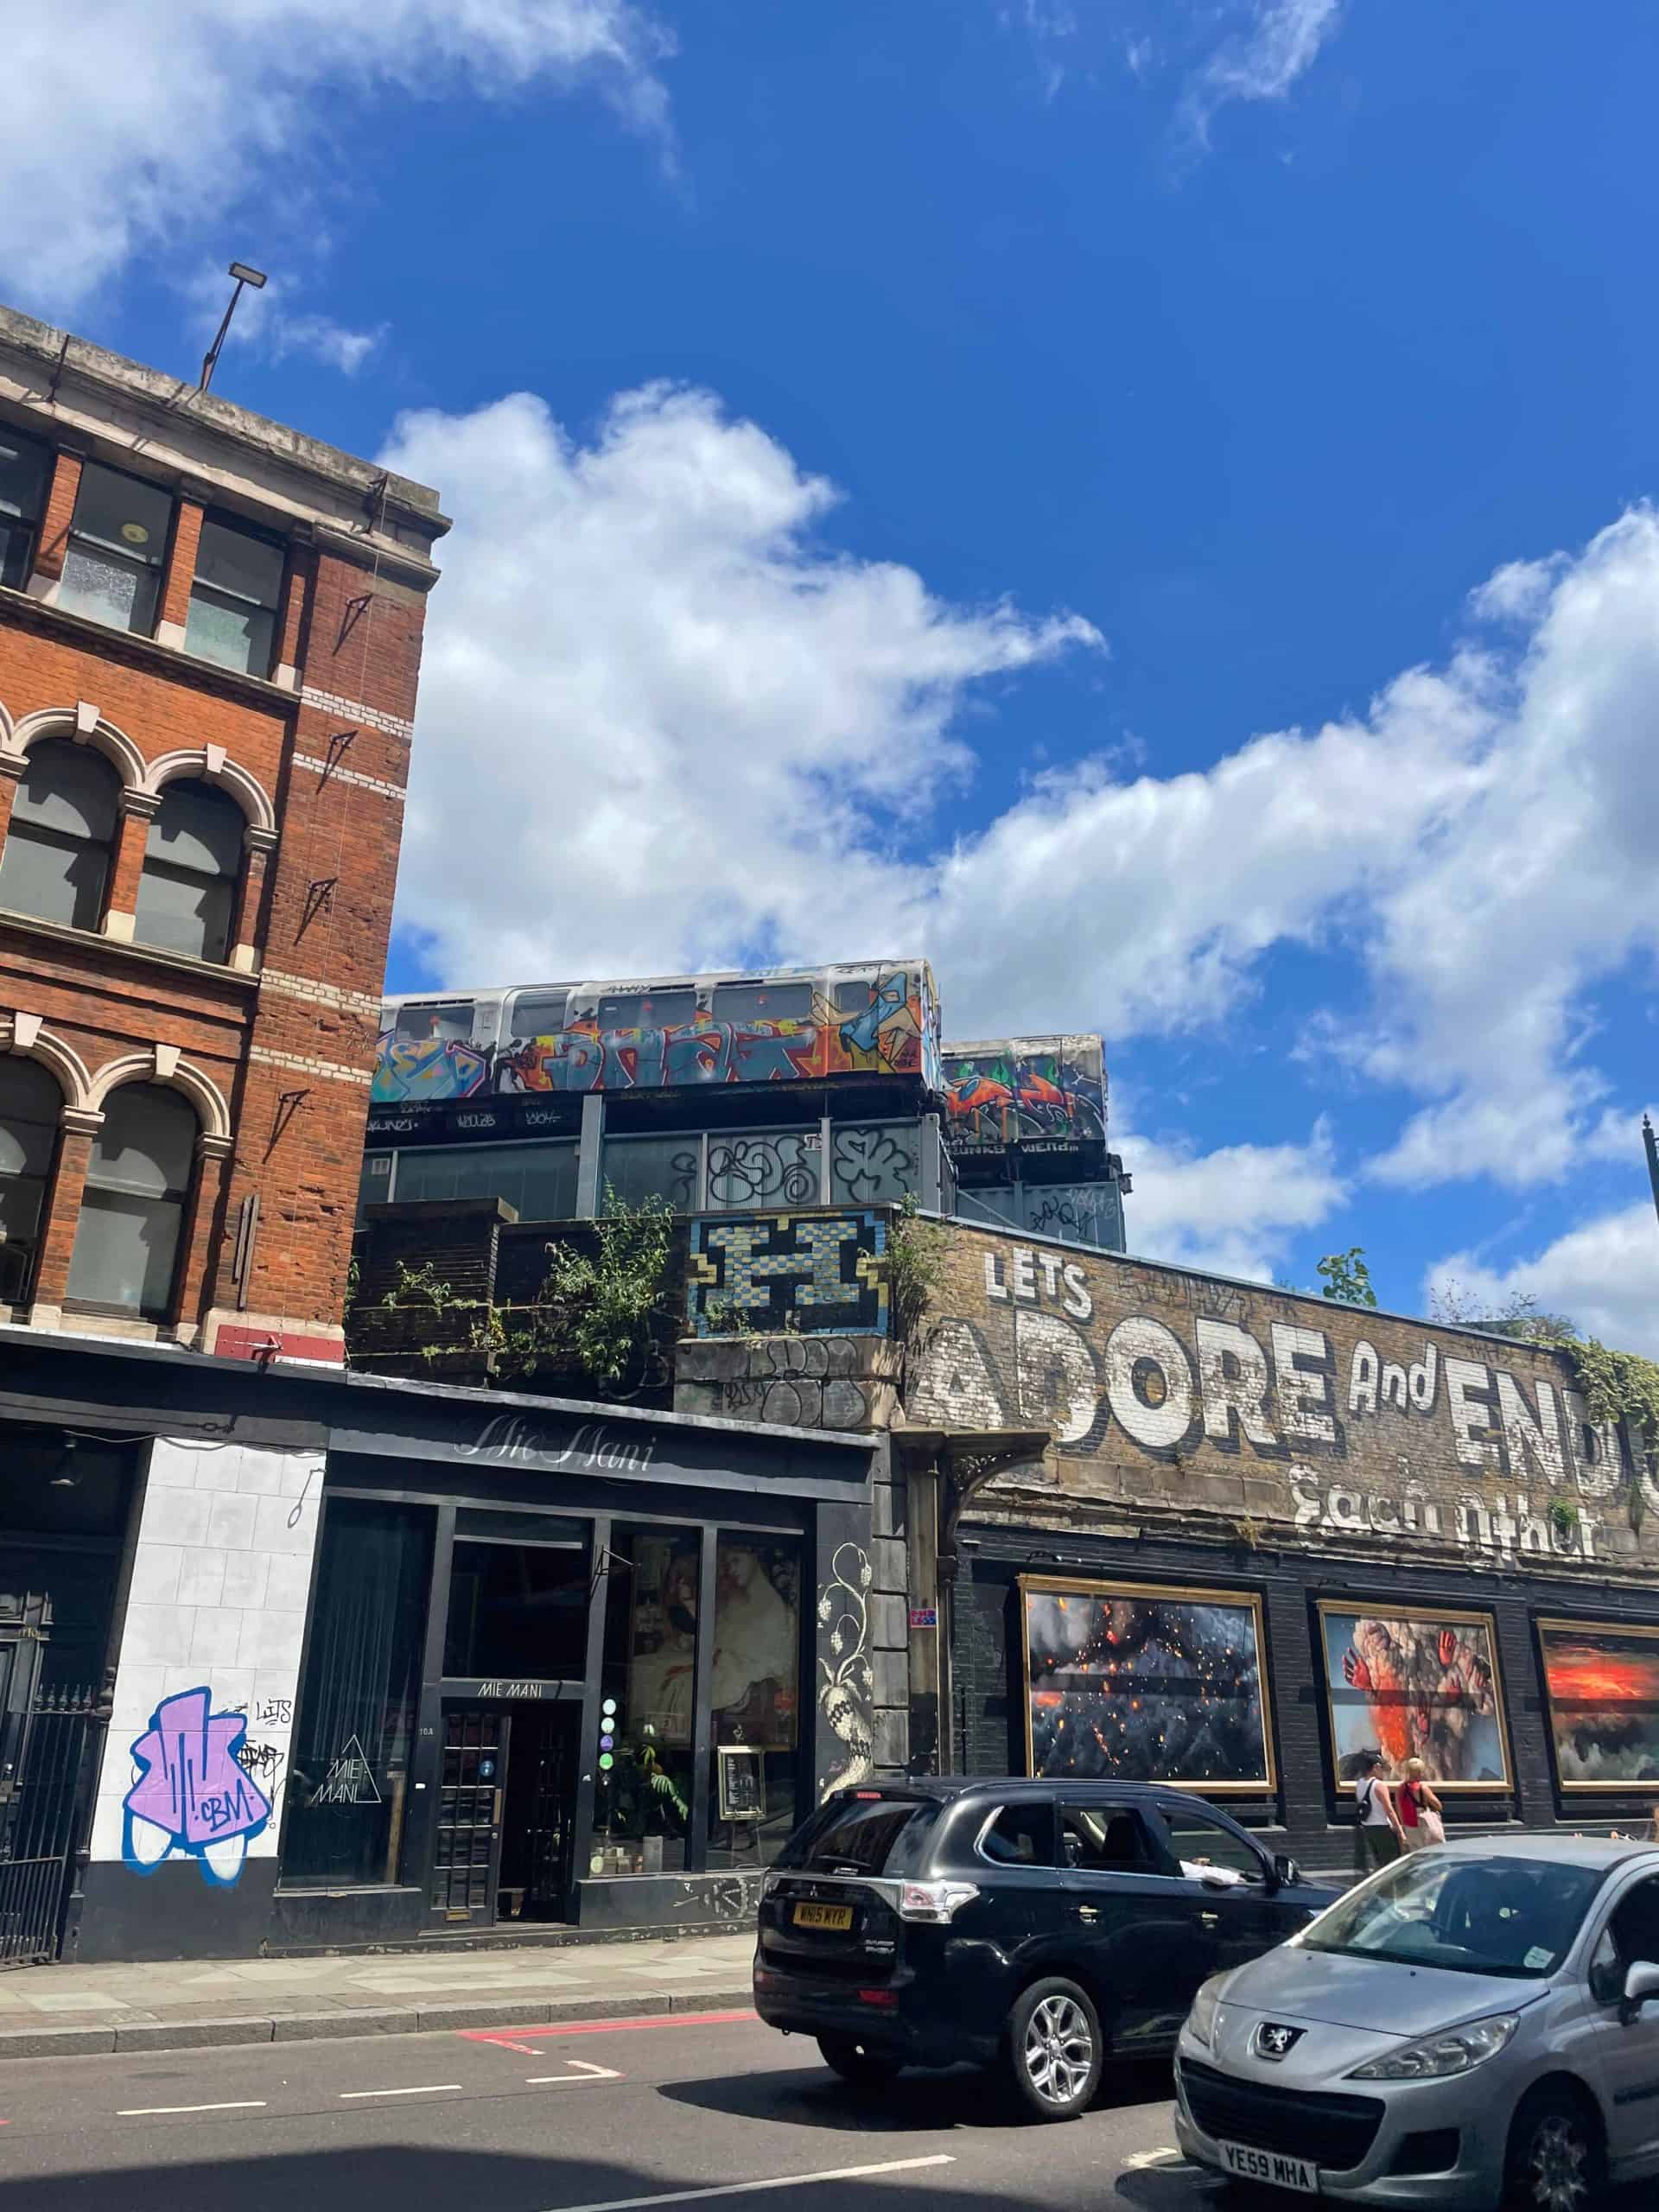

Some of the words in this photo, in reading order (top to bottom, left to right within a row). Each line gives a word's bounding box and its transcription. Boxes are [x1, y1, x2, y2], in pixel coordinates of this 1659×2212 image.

[983, 1246, 1093, 1320] LETS
[904, 1309, 1338, 1448] ADORE
[1348, 1339, 1439, 1412] And
[478, 1682, 504, 1698] MIE
[505, 1683, 543, 1698] MANI
[327, 1758, 360, 1779] MIE
[1225, 2145, 1269, 2177] YE59
[1273, 2158, 1310, 2188] MHA
